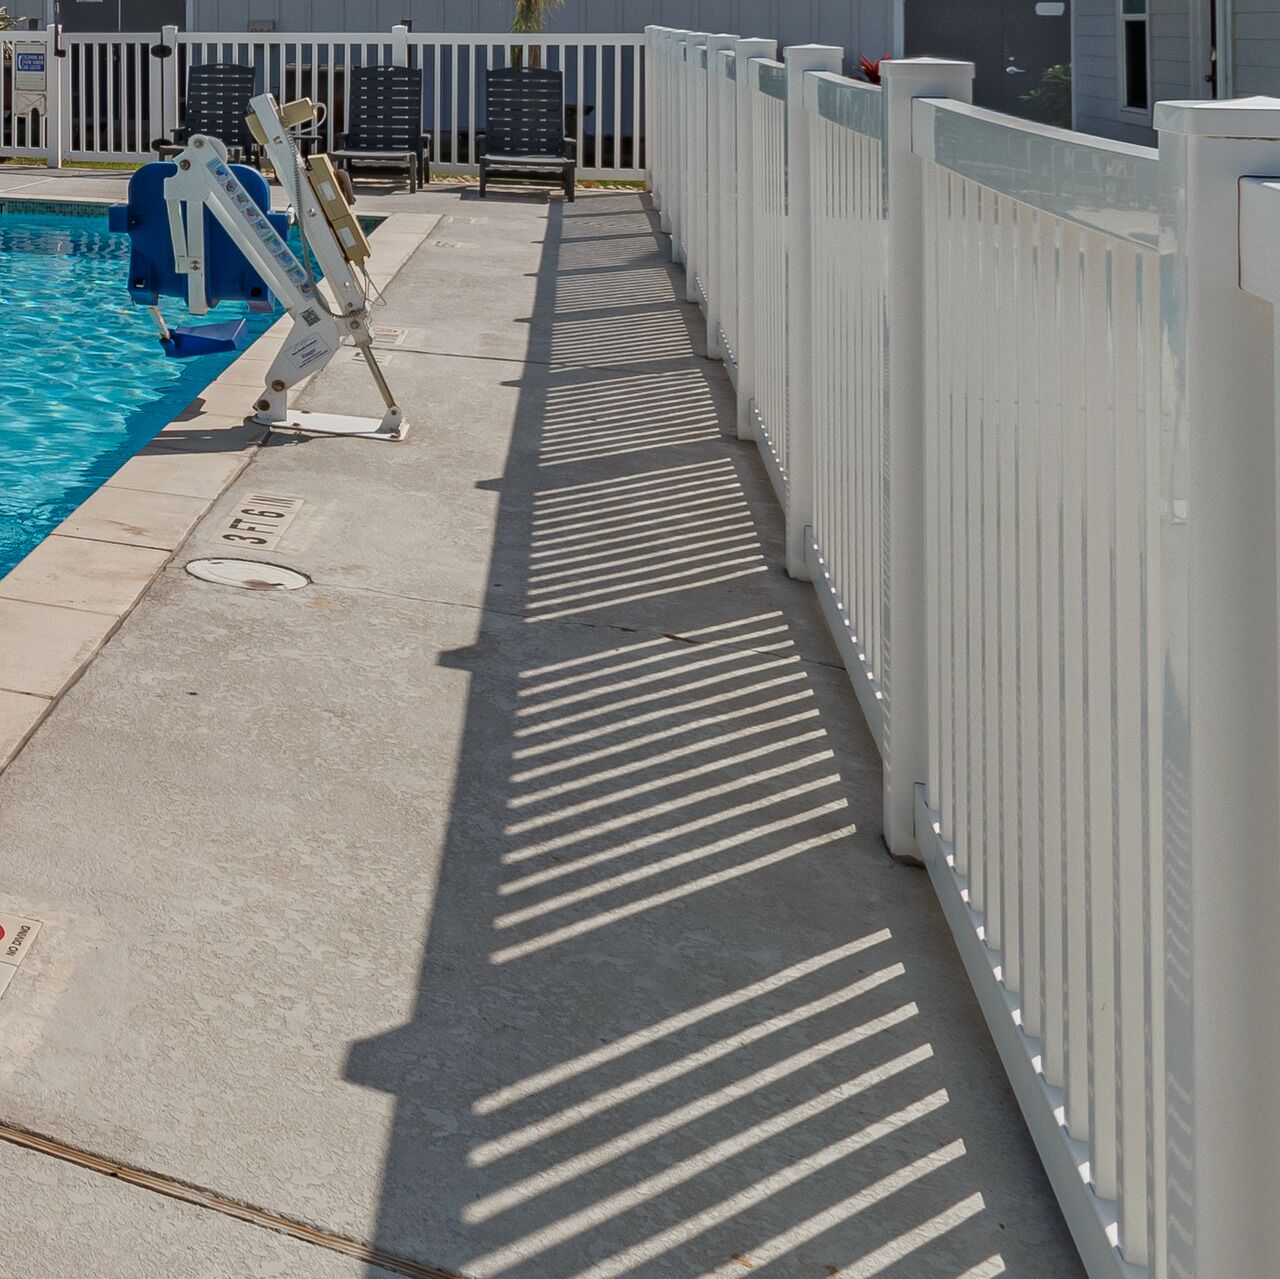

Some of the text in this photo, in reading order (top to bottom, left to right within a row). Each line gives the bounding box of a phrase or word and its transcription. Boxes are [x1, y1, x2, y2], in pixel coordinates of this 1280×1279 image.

[222, 494, 297, 545] 3 FT 6 IN
[5, 924, 31, 957] NO DIVING
